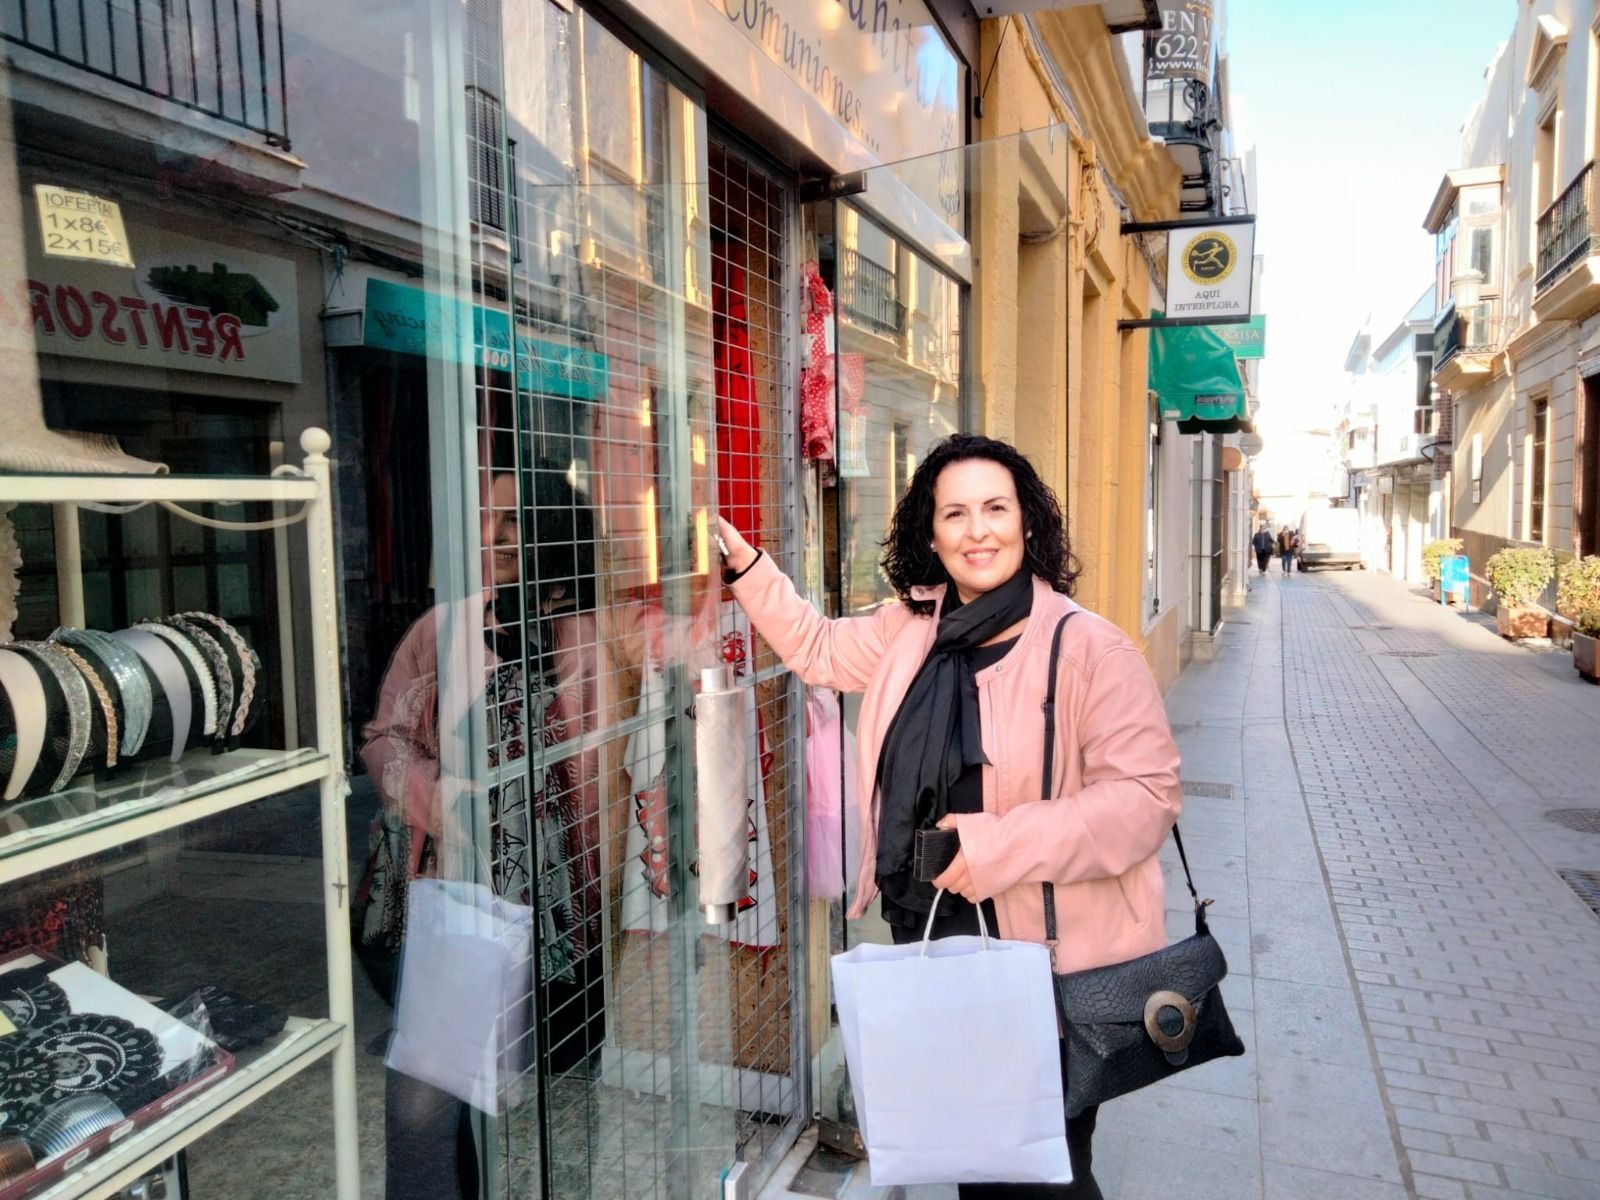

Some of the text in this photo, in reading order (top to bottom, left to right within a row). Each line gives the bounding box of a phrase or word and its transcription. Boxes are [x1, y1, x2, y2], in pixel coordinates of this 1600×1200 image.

[1162, 10, 1196, 33] EN
[1156, 34, 1198, 60] 622
[1174, 300, 1240, 312] INTERFLORA
